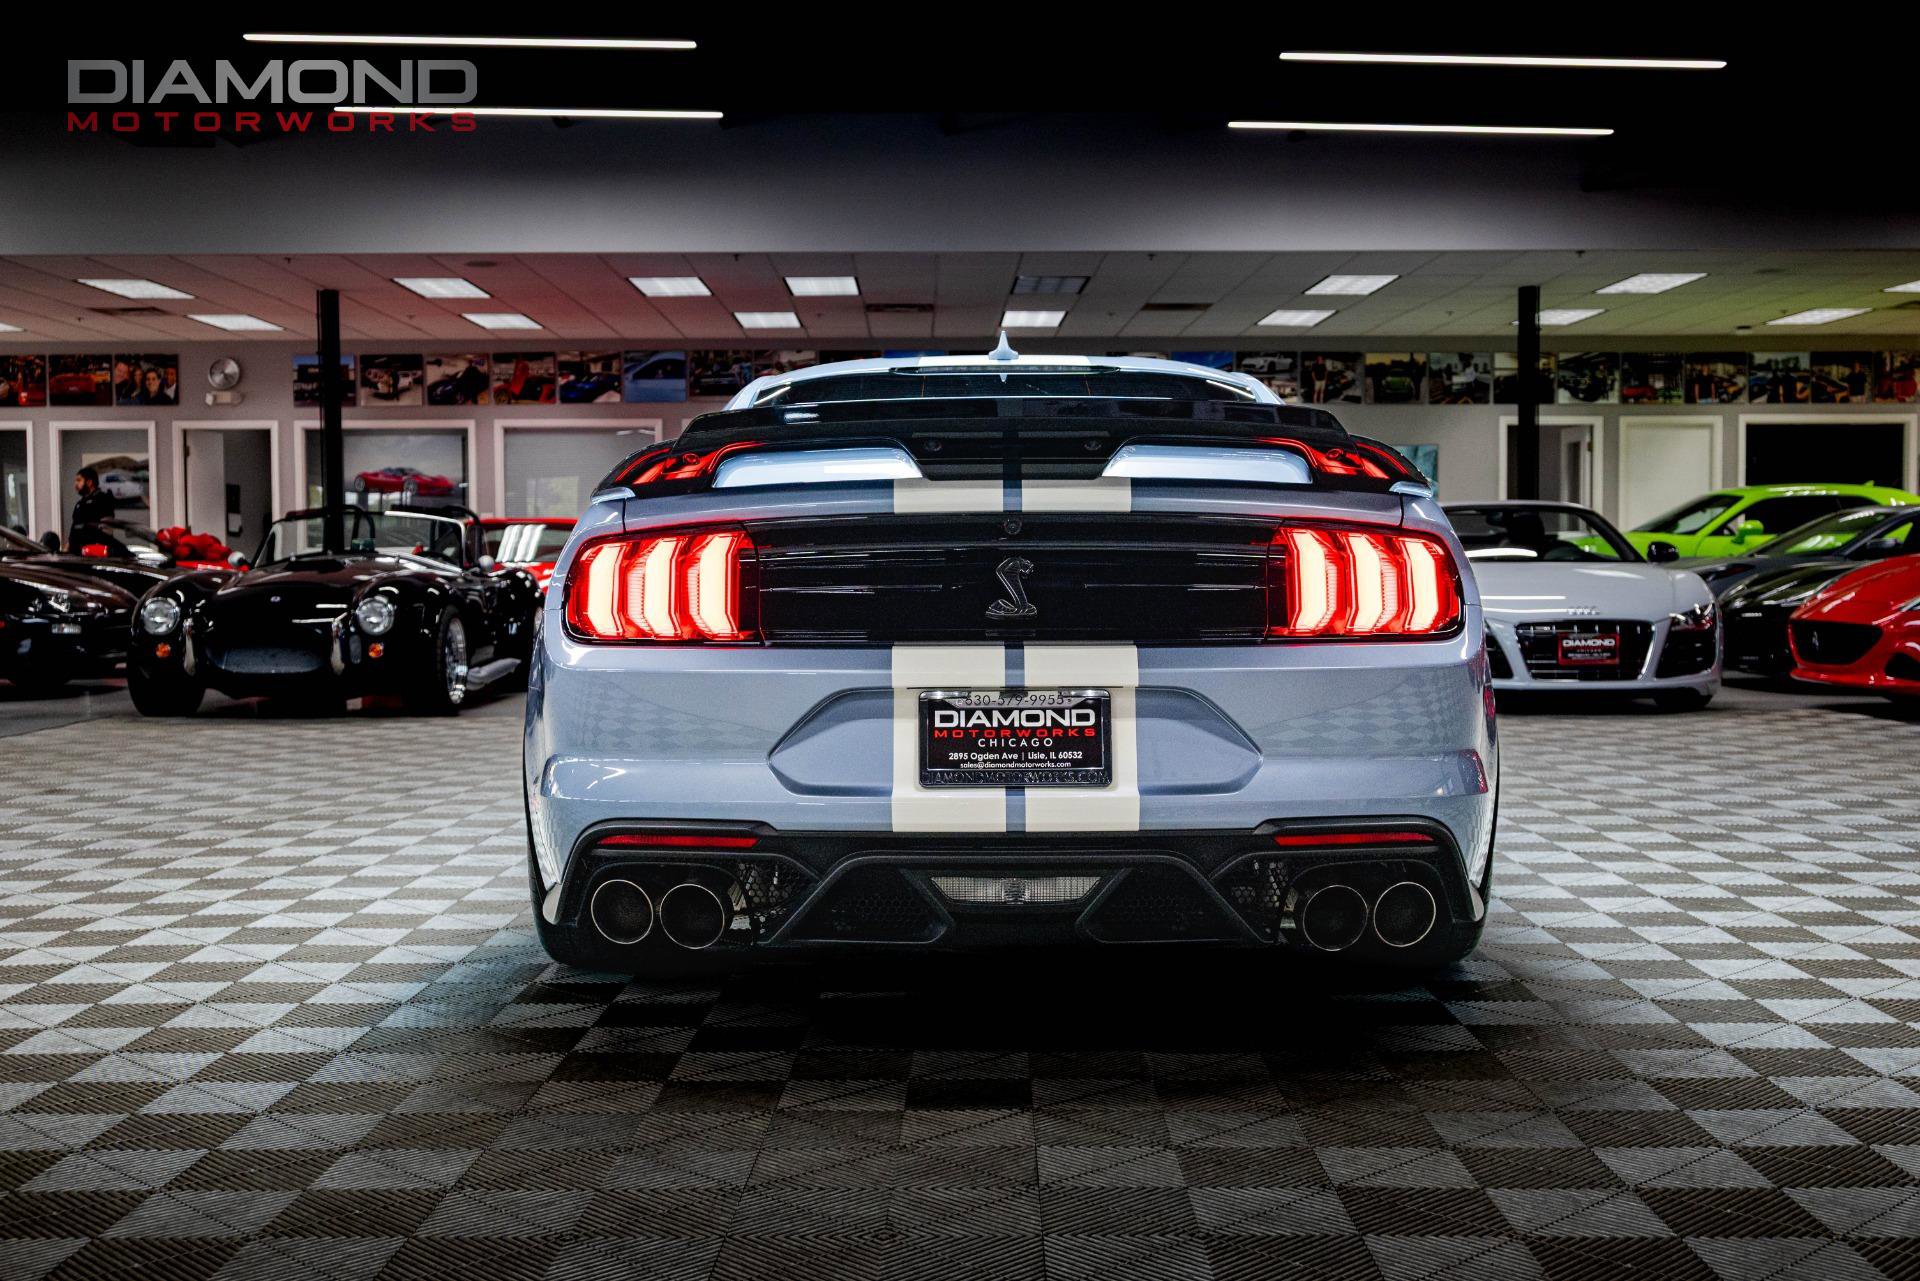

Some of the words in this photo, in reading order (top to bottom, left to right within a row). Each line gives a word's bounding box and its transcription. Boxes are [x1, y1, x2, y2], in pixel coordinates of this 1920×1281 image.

[1562, 639, 1615, 647] DIAMOND
[934, 709, 1096, 728] DIAMOND
[934, 729, 1096, 738] MOTORWORKS
[978, 738, 1053, 747] CHICAGO
[949, 752, 969, 760] 2895
[970, 752, 1000, 762] Ogden
[1001, 752, 1018, 760] Ave
[1028, 752, 1048, 761] Lisle,
[1050, 752, 1057, 760] IL
[1058, 752, 1083, 760] 60532
[960, 760, 1072, 769] sales@diamondmotorworks.com
